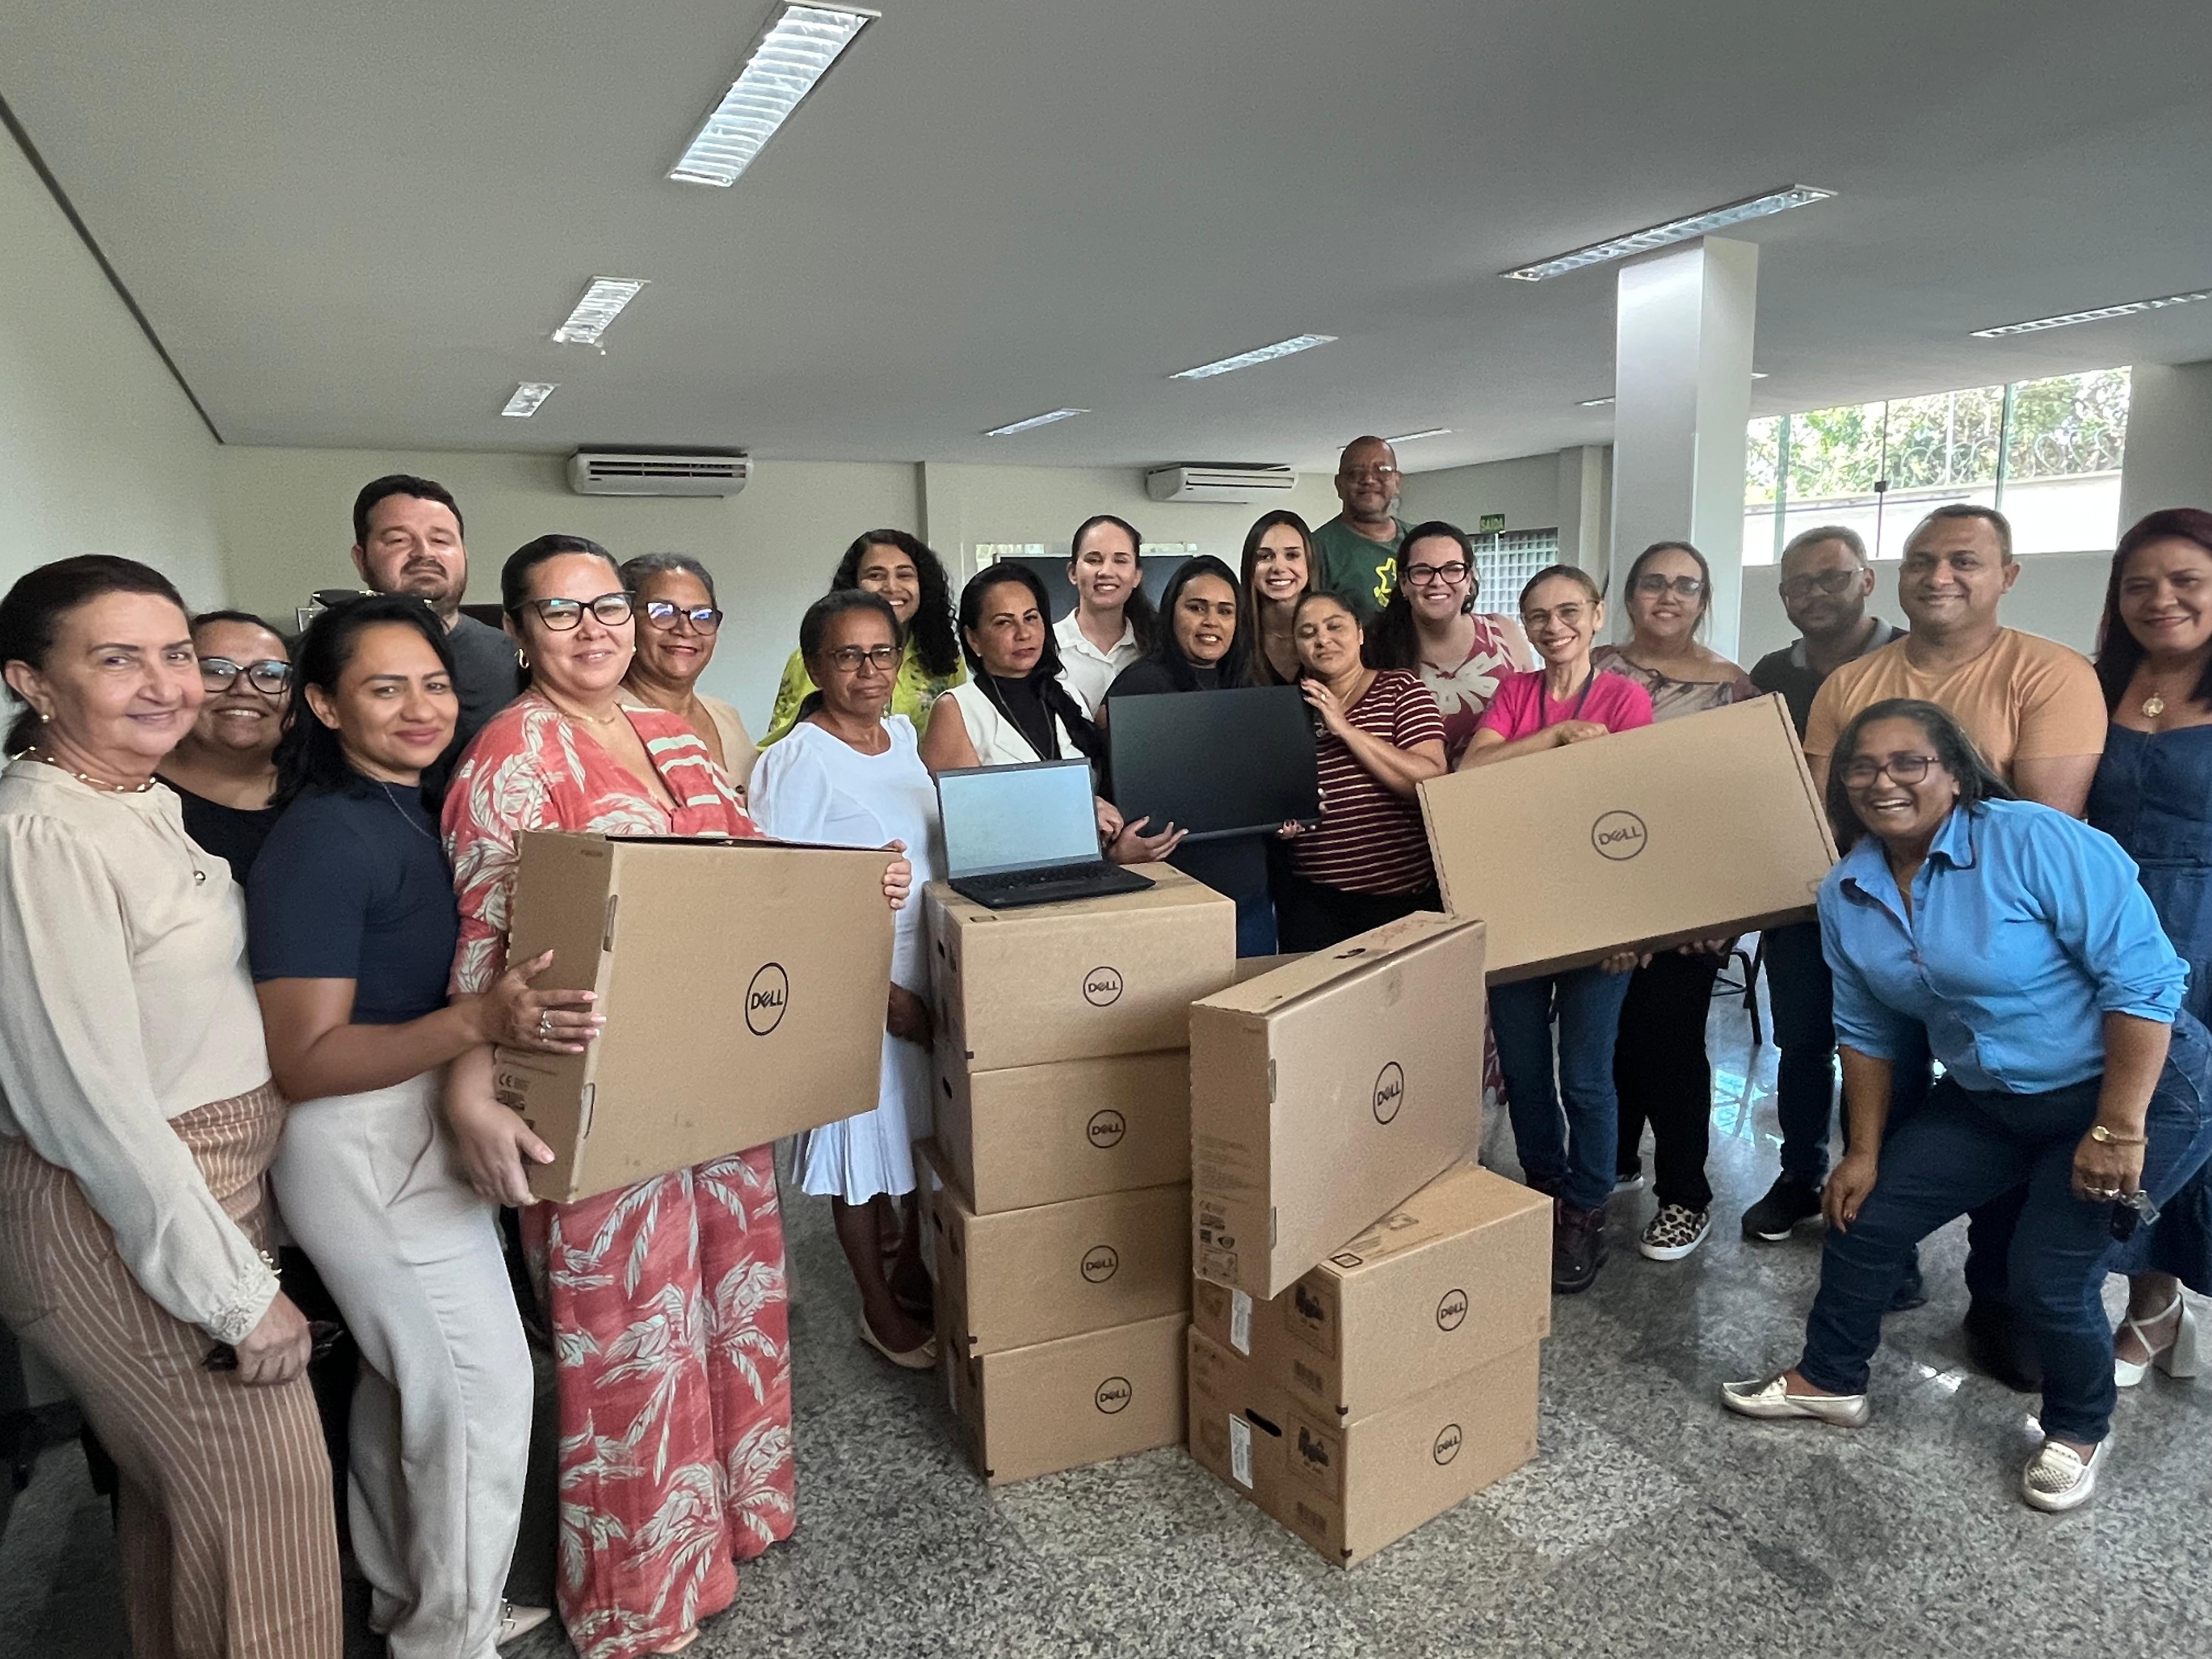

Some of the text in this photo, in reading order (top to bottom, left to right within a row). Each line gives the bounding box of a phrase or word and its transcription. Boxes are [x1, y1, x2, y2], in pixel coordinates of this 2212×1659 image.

[1598, 826, 1642, 845] DELL
[1087, 980, 1119, 993] DELL
[750, 988, 783, 1011] DELL
[1377, 1080, 1402, 1107] DELL
[1092, 1123, 1122, 1136] DELL
[1086, 1257, 1115, 1271] DELL
[1440, 1302, 1464, 1319] DELL
[1099, 1389, 1128, 1402] DELL
[1437, 1436, 1460, 1455] DELL
